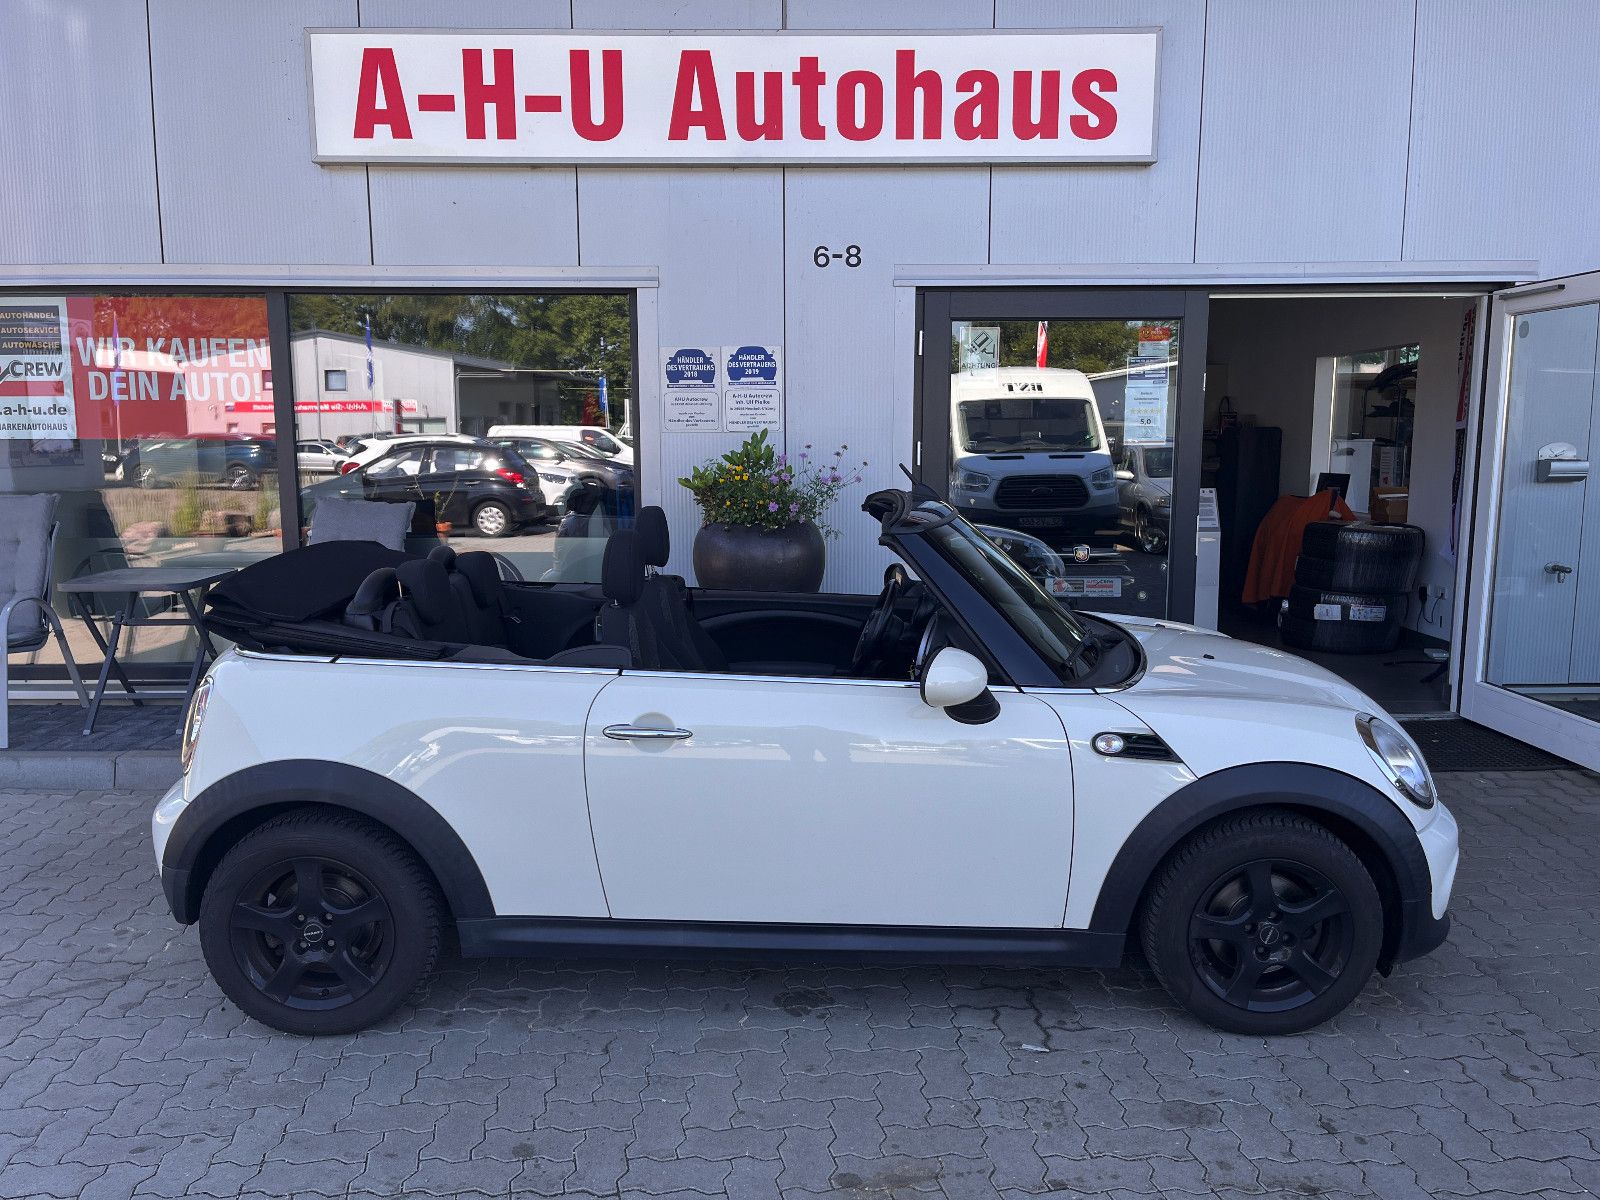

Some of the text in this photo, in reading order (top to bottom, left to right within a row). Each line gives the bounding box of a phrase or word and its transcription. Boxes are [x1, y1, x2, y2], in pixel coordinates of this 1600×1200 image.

[353, 47, 1118, 141] A-H-U Autohaus
[813, 245, 862, 268] 6-8
[2, 340, 60, 349] AUTOWÄSCHE
[76, 337, 269, 368] WIR KAUFEN
[738, 353, 765, 361] HÄNDLER
[677, 355, 704, 363] HÄNDLER
[88, 371, 262, 401] DEIN AUTO!
[1140, 418, 1151, 426] 5,0
[0, 423, 68, 431] ARKENAUTOHAUS
